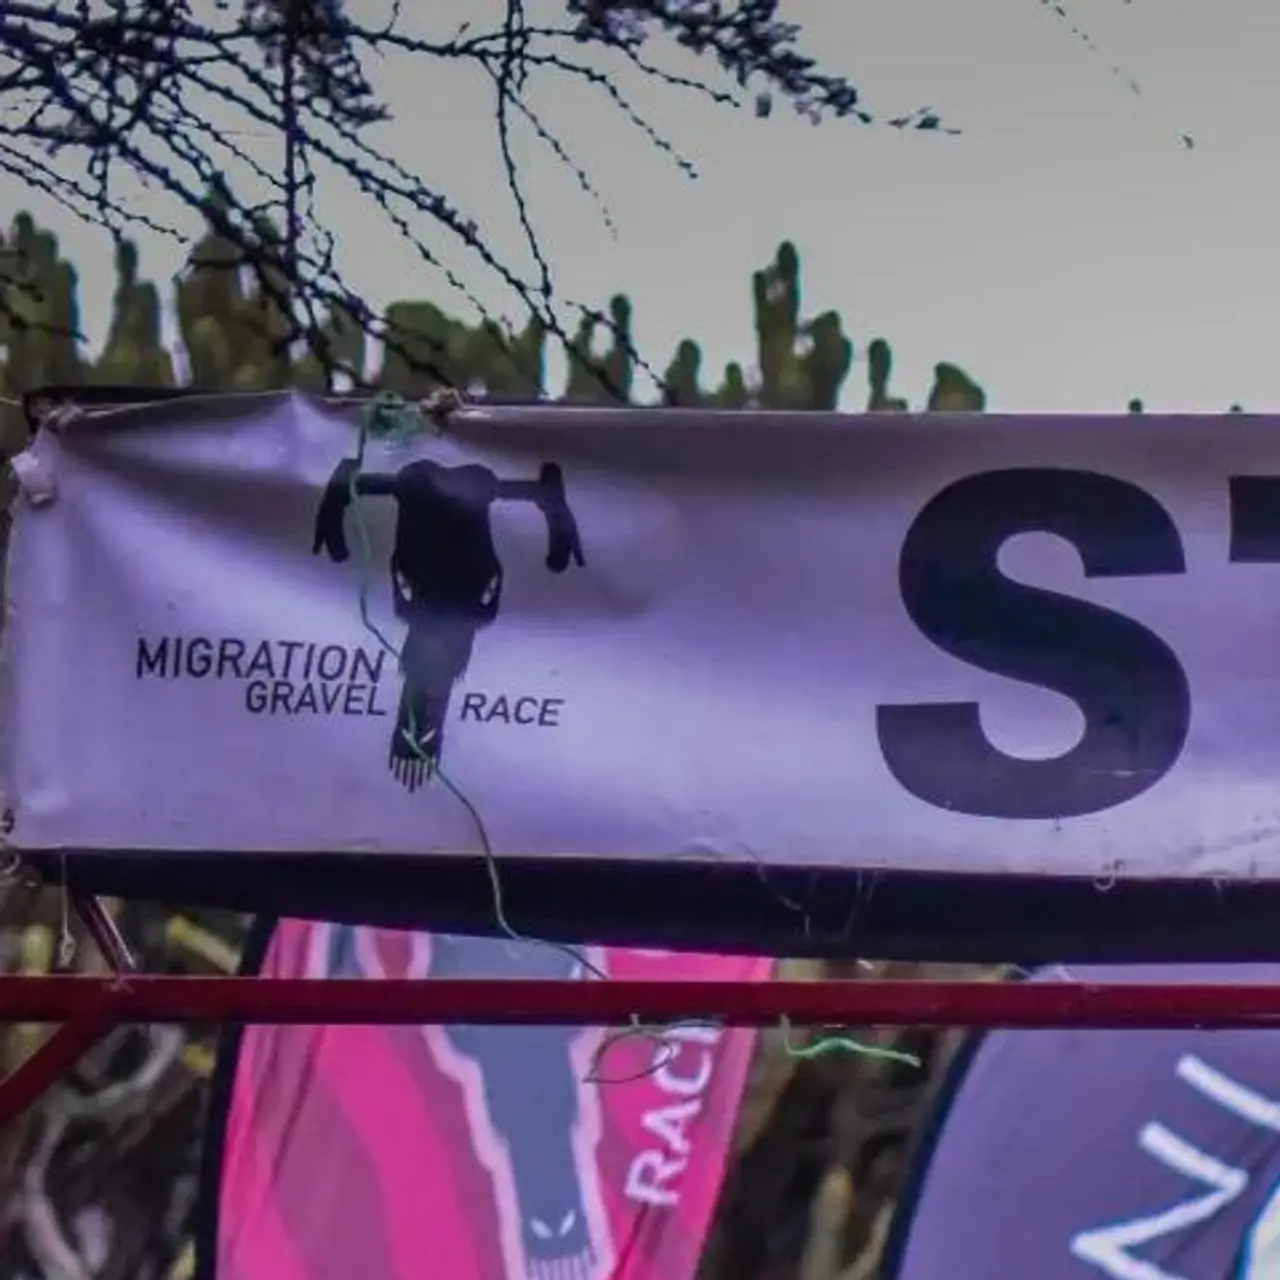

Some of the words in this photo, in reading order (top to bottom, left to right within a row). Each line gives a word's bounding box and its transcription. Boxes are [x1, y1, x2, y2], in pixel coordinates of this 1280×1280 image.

[136, 637, 385, 684] MIGRATION
[246, 681, 388, 719] GRAVEL
[461, 692, 564, 728] RACE
